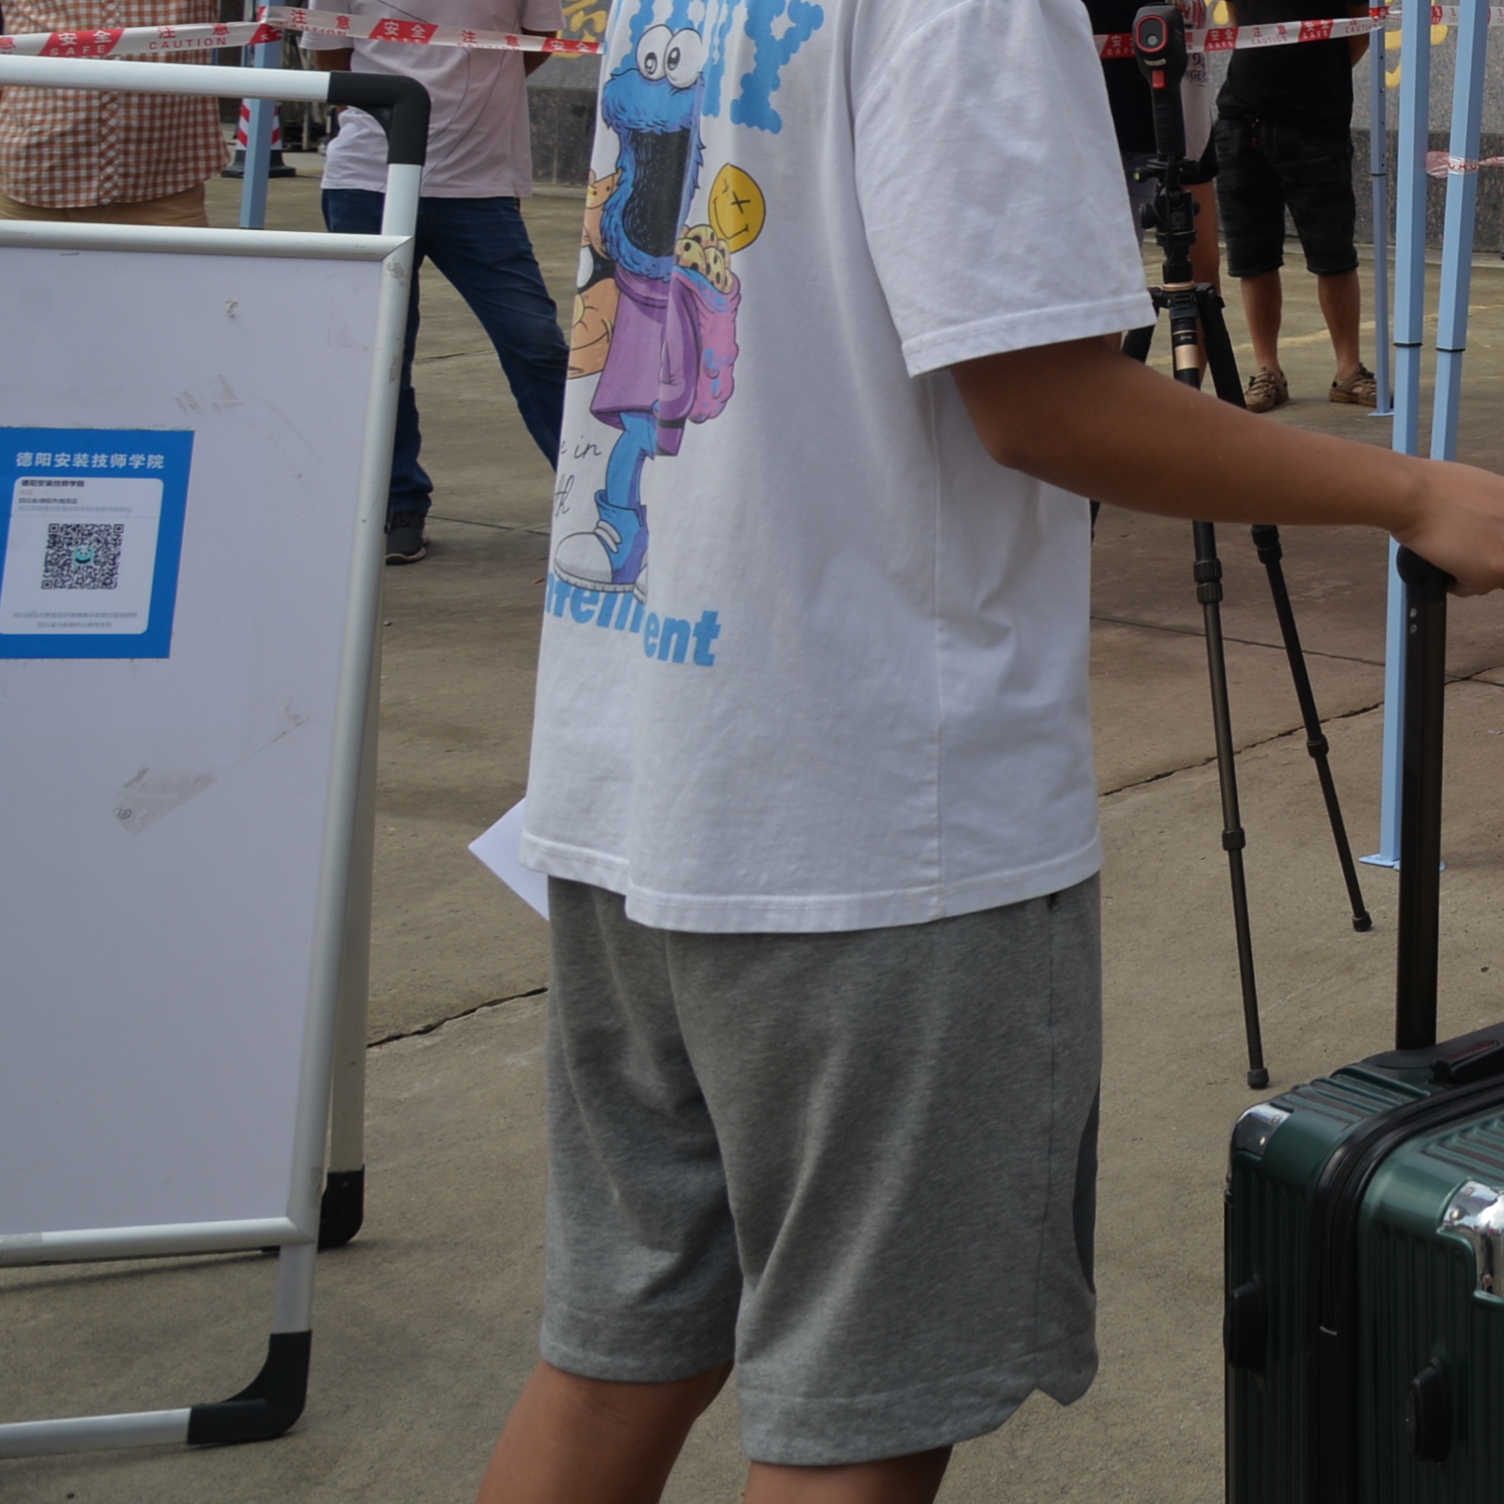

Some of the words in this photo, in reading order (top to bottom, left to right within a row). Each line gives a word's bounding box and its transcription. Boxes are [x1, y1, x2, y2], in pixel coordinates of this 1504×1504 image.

[50, 45, 105, 56] SAFE
[148, 37, 228, 50] CAUTION
[58, 30, 113, 45] 安全
[15, 451, 165, 470] 德阳安装技师学院
